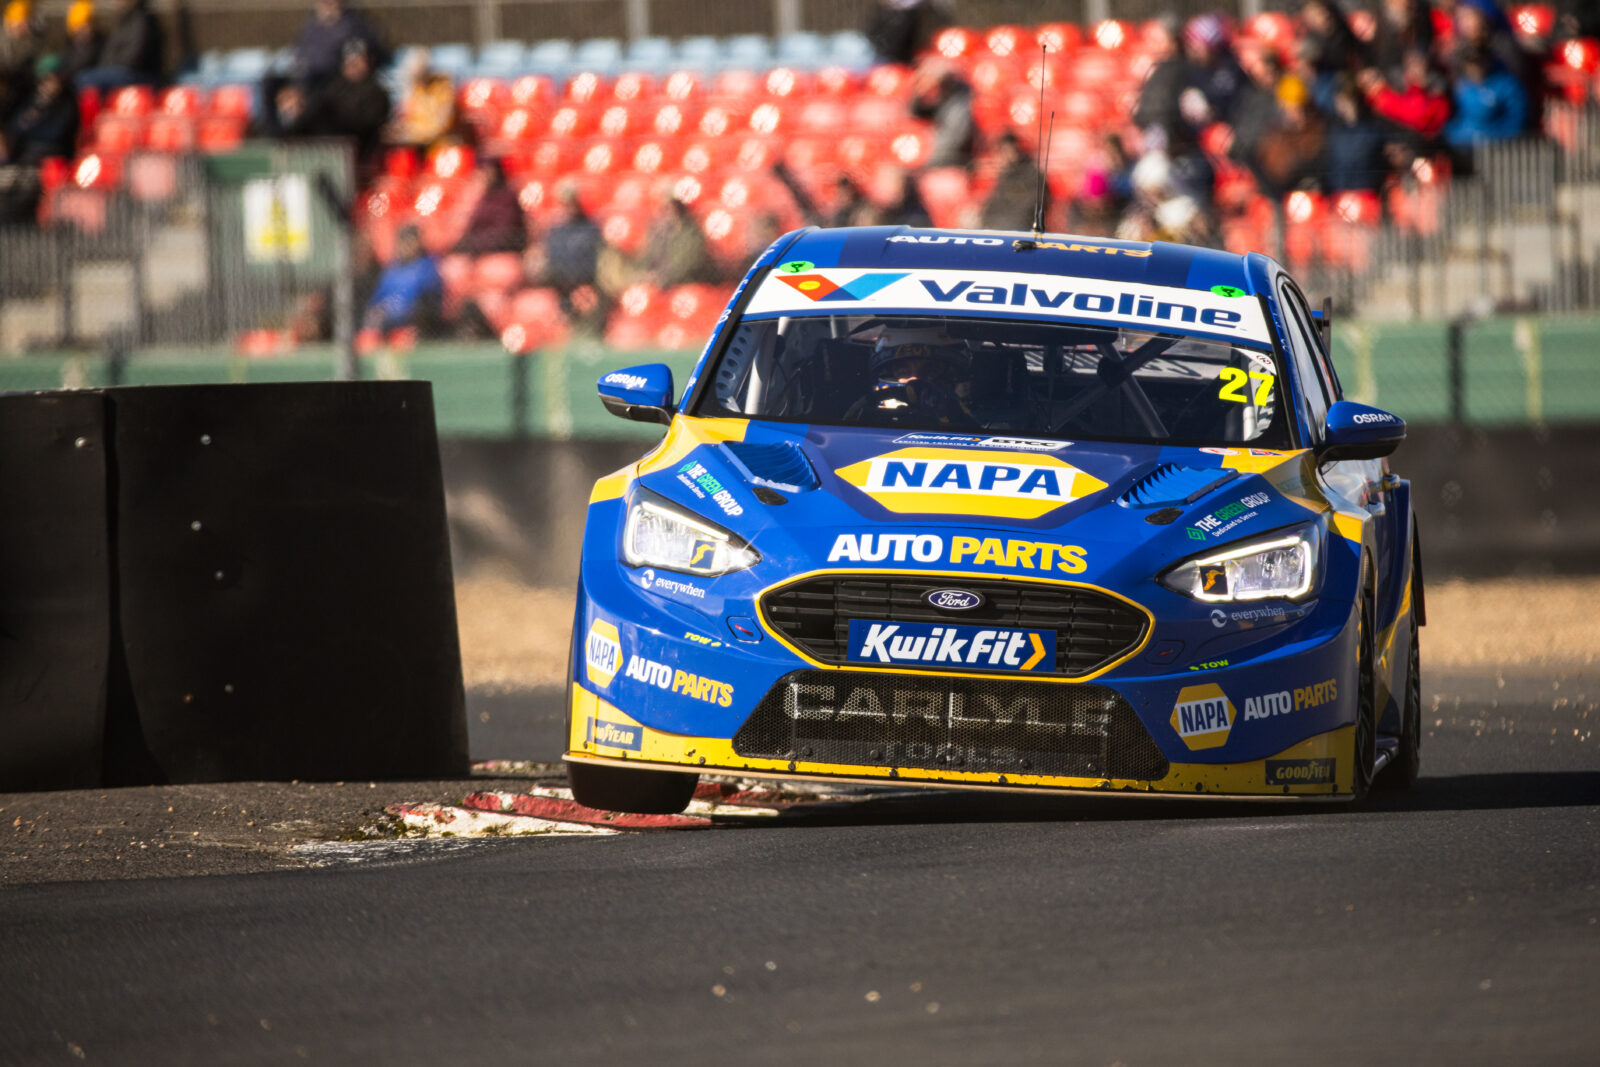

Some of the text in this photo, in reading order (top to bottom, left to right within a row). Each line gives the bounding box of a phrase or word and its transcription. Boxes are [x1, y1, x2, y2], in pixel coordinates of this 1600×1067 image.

[886, 235, 1004, 246] AUTO
[919, 279, 1241, 328] Valvoline
[605, 373, 648, 390] OSRAM
[1219, 367, 1274, 407] 27
[1353, 413, 1394, 424] OSRAM
[696, 472, 724, 495] GREEN
[712, 489, 744, 516] GROUP
[881, 461, 1061, 496] NAPA
[1194, 491, 1271, 532] THE GREEN GROUP
[827, 534, 1088, 574] AUTO PARTS
[655, 576, 705, 599] everywhen
[938, 591, 970, 607] Ford
[1230, 605, 1285, 622] everywhen
[589, 635, 615, 674] NAPA
[684, 632, 712, 645] TOW
[625, 655, 735, 708] AUTO PARTS
[1200, 659, 1229, 670] TOW
[784, 683, 1112, 736] CARLYLE
[1181, 700, 1228, 734] NAPA
[1244, 679, 1338, 722] AUTO PARTS
